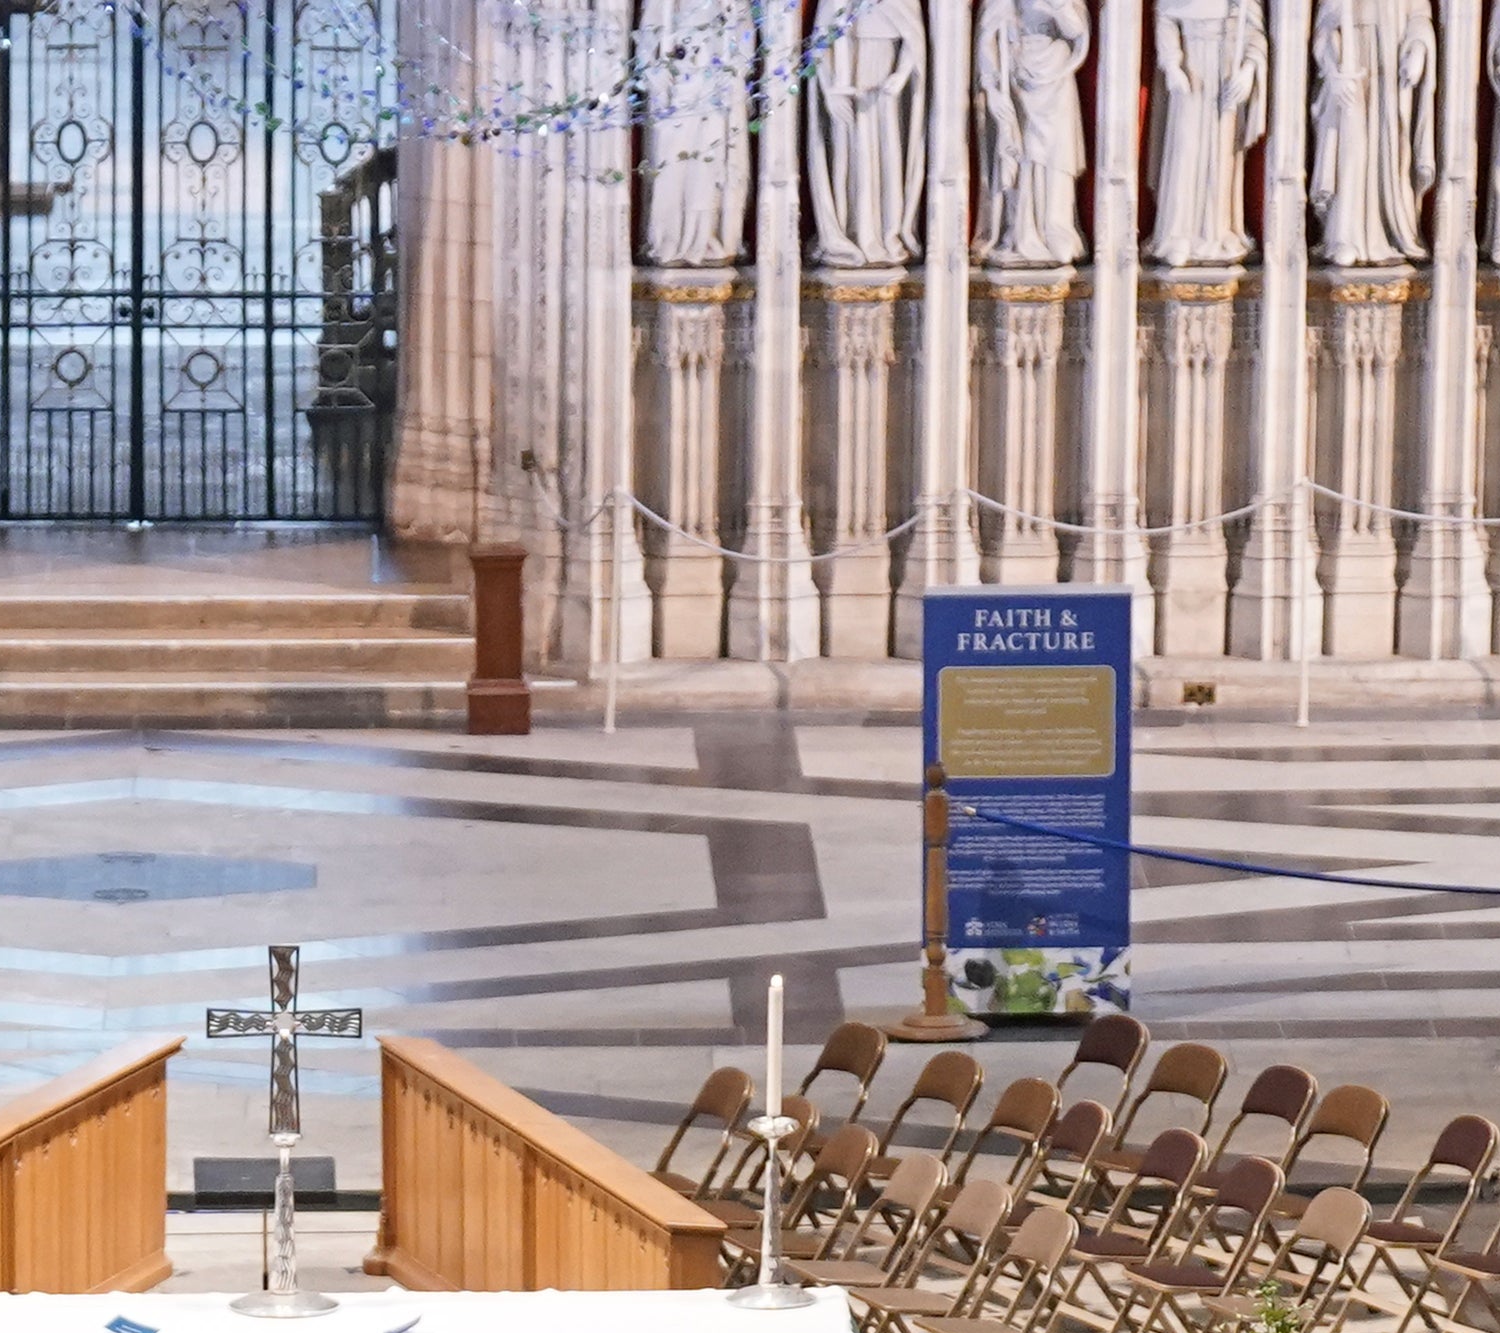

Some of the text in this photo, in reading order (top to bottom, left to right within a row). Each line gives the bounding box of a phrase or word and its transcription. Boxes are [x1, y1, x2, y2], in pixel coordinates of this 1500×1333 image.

[974, 608, 1078, 628] FAITH &
[957, 631, 1095, 651] FRACTURE
